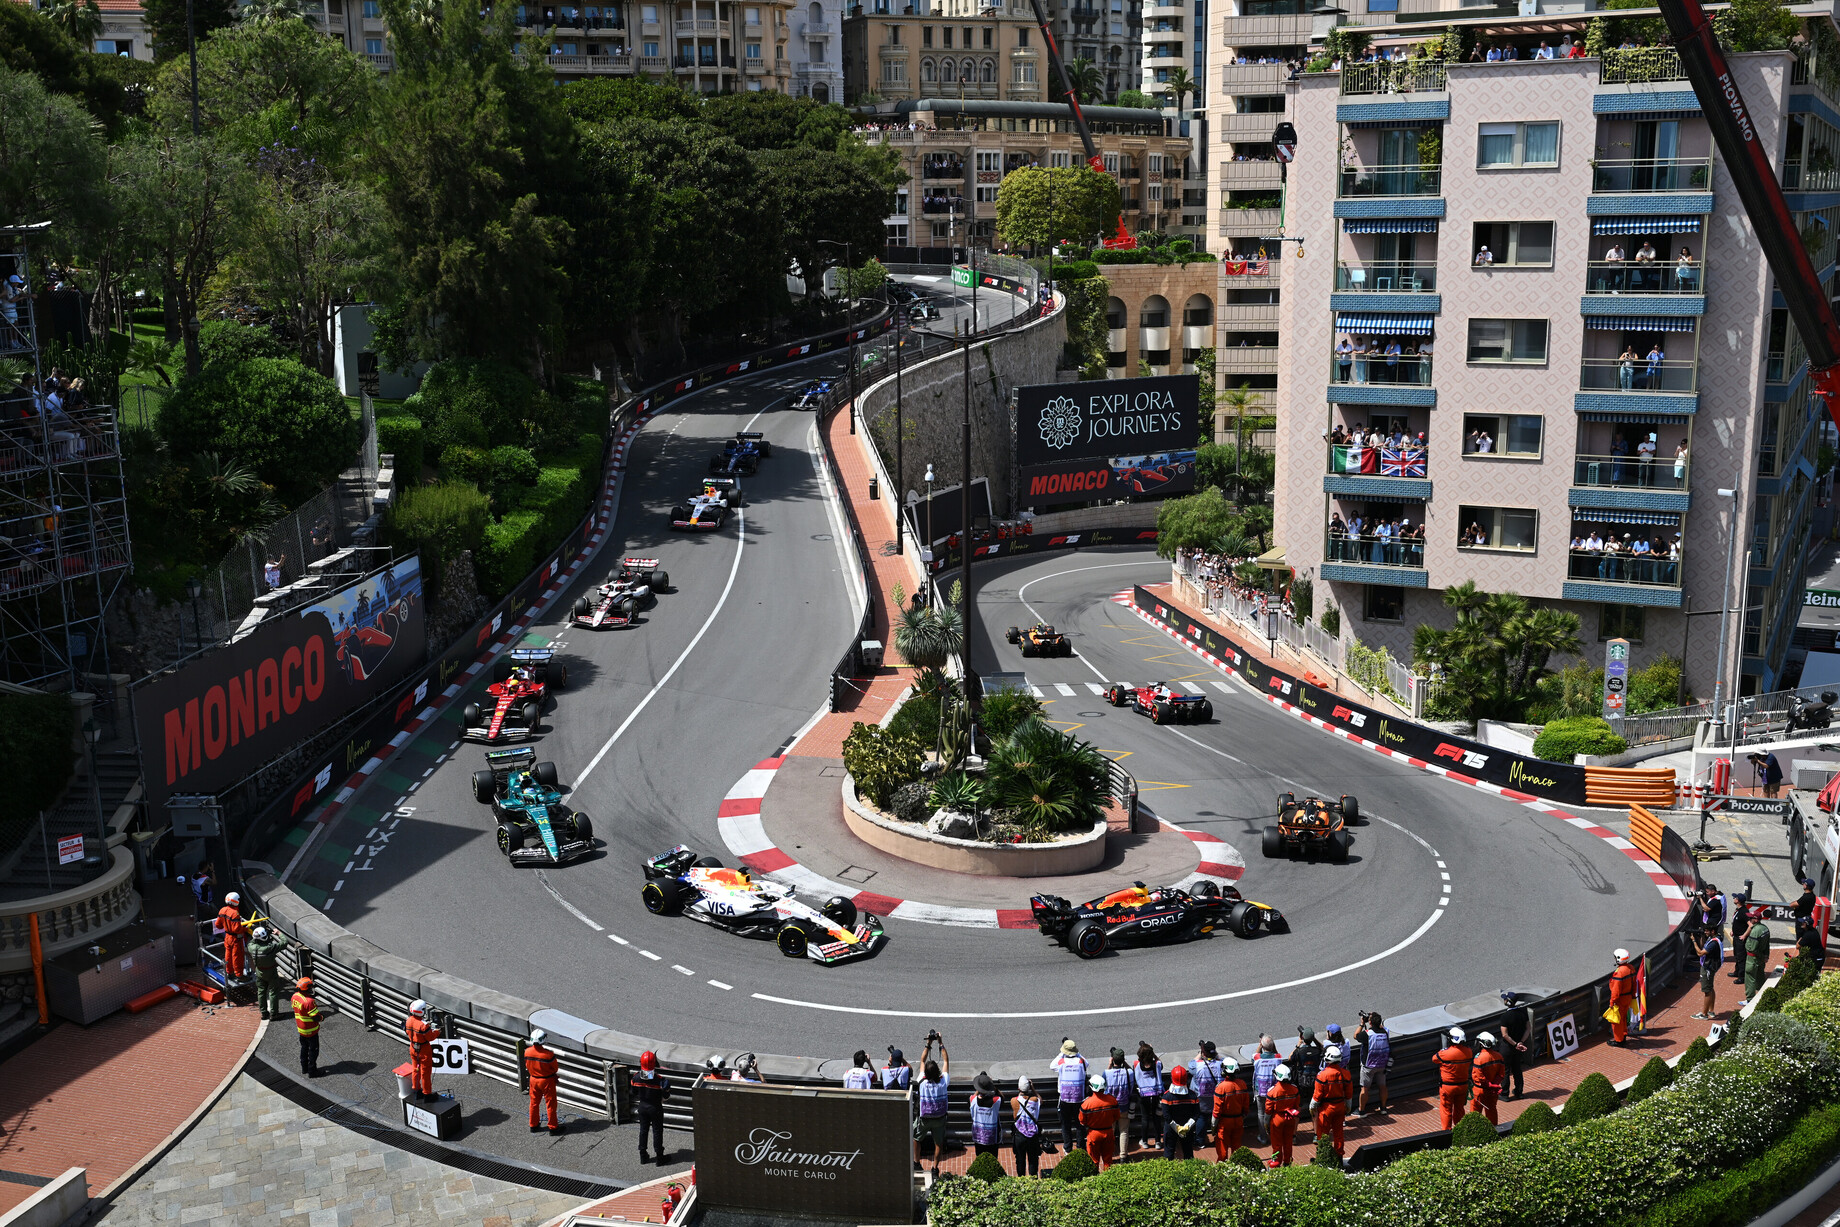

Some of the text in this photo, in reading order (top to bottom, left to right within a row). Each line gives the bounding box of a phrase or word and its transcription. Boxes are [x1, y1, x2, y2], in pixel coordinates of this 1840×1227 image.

[1719, 73, 1753, 142] PIOVANO
[1090, 391, 1175, 415] EXPLORA
[1087, 412, 1181, 443] JOURNEYS
[1030, 470, 1109, 495] MONACO
[164, 634, 325, 786] MONACO
[1509, 761, 1557, 788] Monaco
[354, 806, 417, 871] TAXIS
[707, 901, 736, 916] VISA
[1121, 914, 1135, 922] Bull
[1140, 912, 1184, 928] ORACLE
[1552, 1022, 1574, 1051] SC
[431, 1044, 463, 1068] SC
[735, 1128, 865, 1170] Fairmont
[764, 1168, 837, 1180] MONTE CARLO
